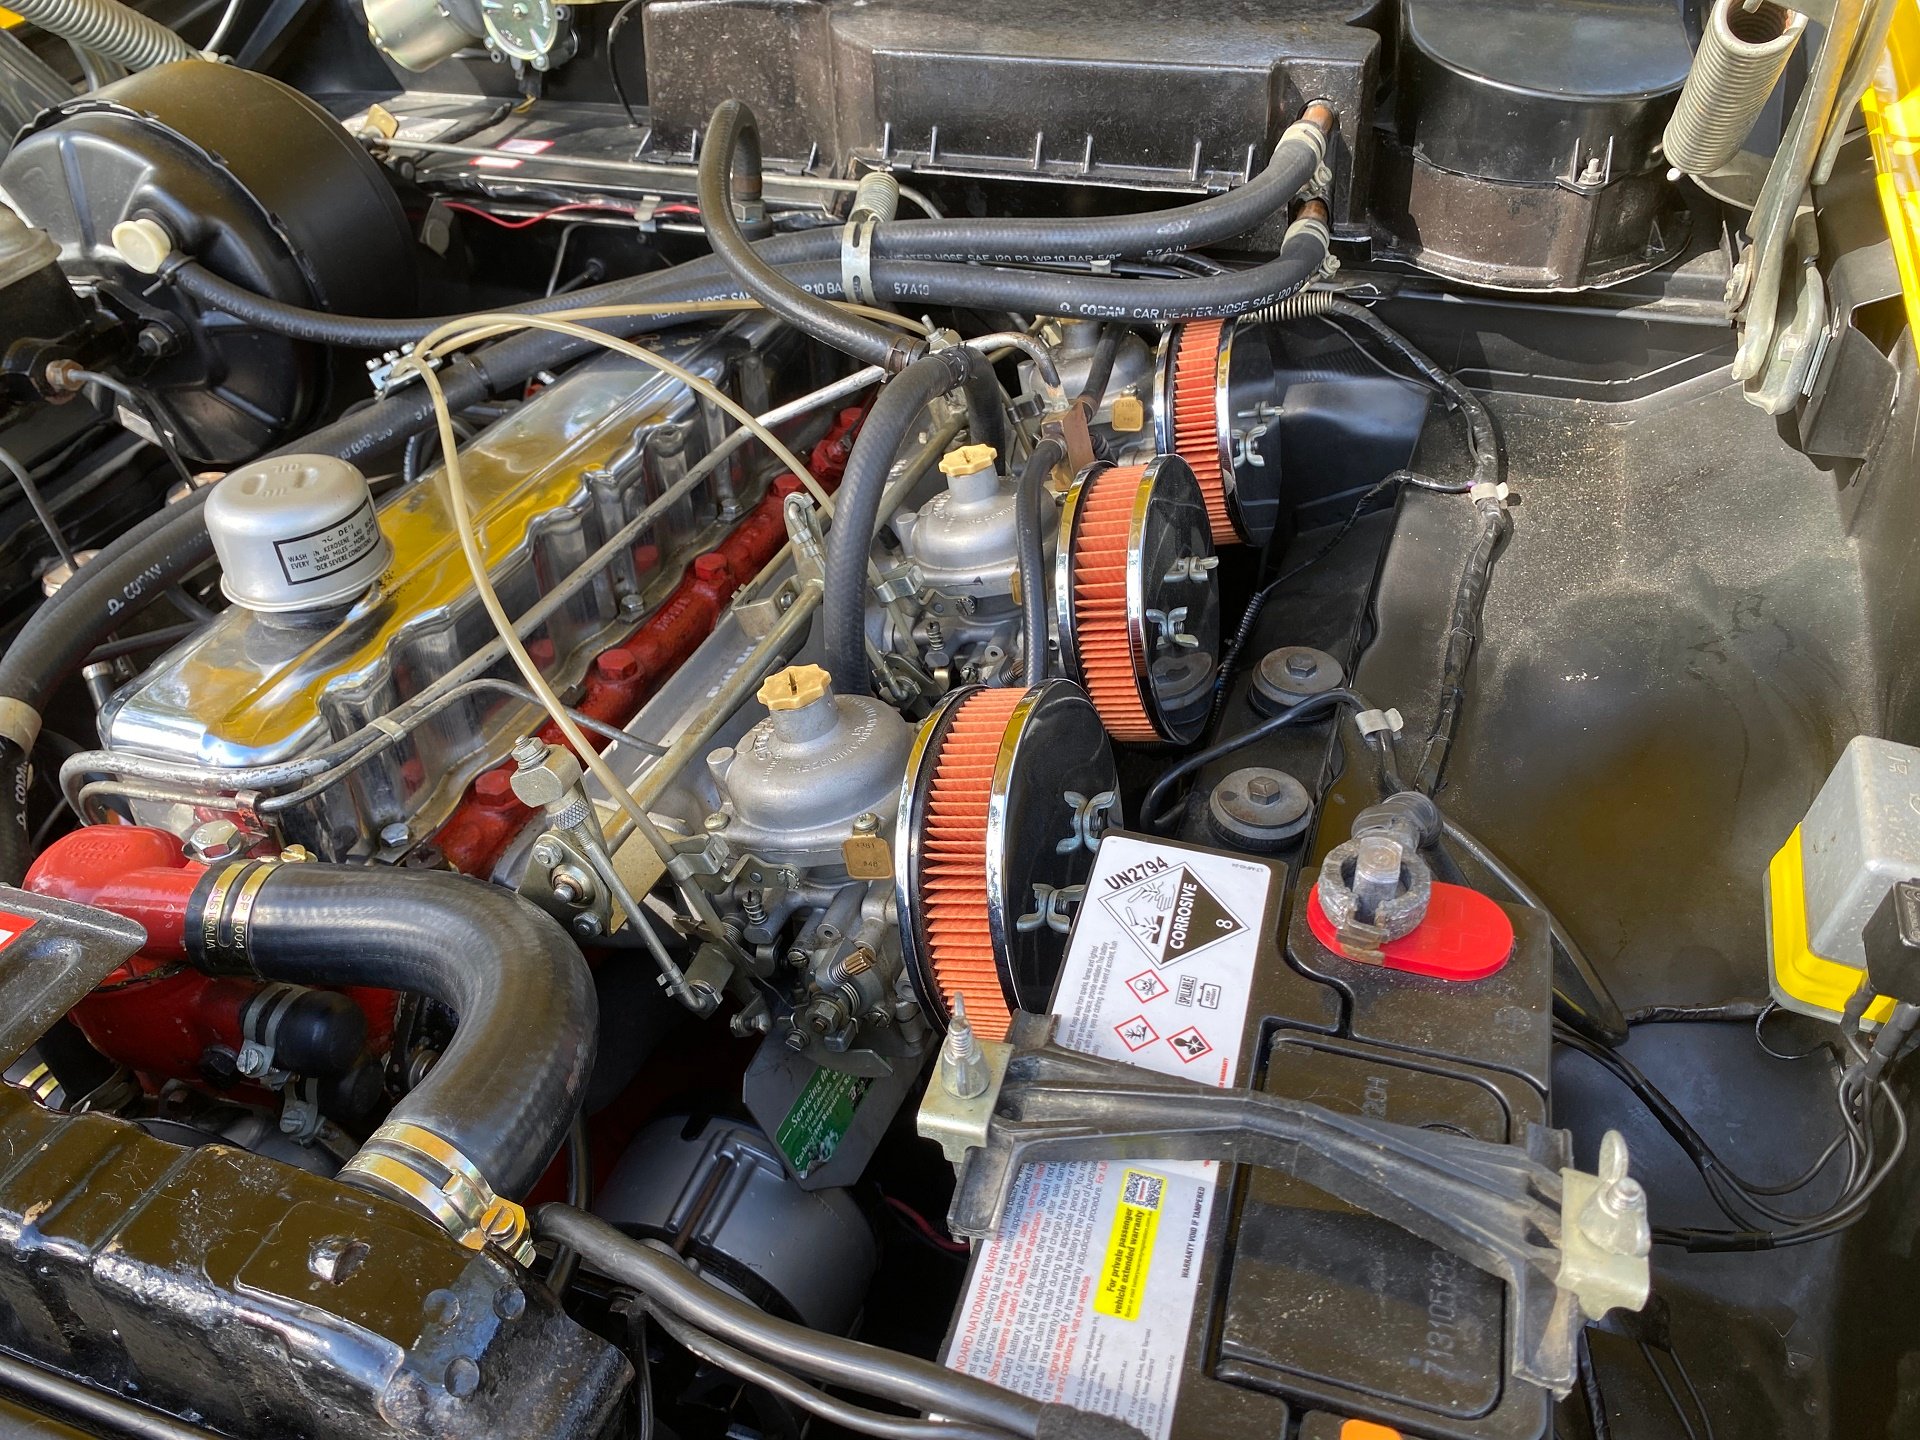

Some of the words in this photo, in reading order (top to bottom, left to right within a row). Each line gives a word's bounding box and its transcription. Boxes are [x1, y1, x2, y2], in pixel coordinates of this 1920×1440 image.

[827, 282, 842, 295] BA
[204, 289, 254, 319] VACUUM
[1132, 307, 1159, 319] CAR
[1163, 306, 1213, 319] HEATER
[1218, 300, 1249, 315] HOSE
[1252, 293, 1275, 307] SAE
[1275, 286, 1292, 301] J20
[288, 553, 308, 563] WASH
[323, 536, 350, 553] KEROSENE
[290, 560, 310, 570] EVERY
[332, 546, 348, 557] MILES
[329, 553, 348, 567] SEVERE
[1104, 856, 1169, 890] UN2794
[205, 887, 224, 950] AUSTRALIA
[1169, 882, 1198, 950] CORROSIVE
[1215, 918, 1233, 930] 8
[1177, 977, 1195, 1005] SPILLABLE
[791, 1080, 821, 1128] Servicing
[822, 1094, 840, 1121] Repairs
[1098, 1159, 1108, 1171] full
[1021, 1172, 1032, 1194] period
[1061, 1177, 1072, 1198] dealer
[1074, 1172, 1084, 1184] You
[1095, 1173, 1104, 1184] For
[1051, 1183, 1060, 1197] sale
[1082, 1189, 1090, 1197] of
[1046, 1199, 1055, 1215] after
[1057, 1199, 1067, 1210] the
[1078, 1198, 1089, 1217] place
[1192, 1186, 1204, 1217] TAMPERED
[1011, 1196, 1025, 1229] applicable
[1055, 1210, 1065, 1220] by
[1074, 1217, 1083, 1228] the
[1041, 1217, 1051, 1232] than
[1049, 1221, 1061, 1244] charge
[1059, 1213, 1073, 1248] applicable
[1188, 1227, 1197, 1241] VOID
[1004, 1230, 1015, 1251] stated
[1036, 1235, 1046, 1252] other
[1046, 1245, 1054, 1253] of
[1066, 1237, 1080, 1260] battery
[1077, 1223, 1092, 1264] adjudication
[1106, 1279, 1116, 1291] For
[1112, 1249, 1122, 1276] private
[1119, 1208, 1132, 1247] passenger
[996, 1328, 1009, 1358] systems
[1004, 1318, 1012, 1326] or
[1008, 1298, 1018, 1316] used
[1014, 1269, 1026, 1288] Deep
[1020, 1247, 1032, 1267] Cycle
[1037, 1183, 1050, 1206] Should
[1046, 1166, 1055, 1177] not
[999, 1253, 1009, 1264] the
[1041, 1254, 1052, 1267] free
[1054, 1250, 1064, 1261] the
[1115, 1285, 1126, 1313] vehicle
[1122, 1246, 1134, 1282] extended
[1130, 1210, 1144, 1244] warranty
[1182, 1243, 1193, 1277] WARRANTY
[995, 1266, 1005, 1275] for
[1029, 1255, 1040, 1279] reason
[1048, 1263, 1062, 1286] during
[1062, 1262, 1072, 1273] the
[979, 1365, 987, 1374] of
[994, 1290, 1011, 1321] Warranty
[1008, 1262, 1017, 1277] void
[1013, 1241, 1022, 1259] when
[1020, 1221, 1029, 1237] used
[1028, 1182, 1039, 1208] vehicles
[991, 1277, 1002, 1292] fault
[1024, 1281, 1035, 1296] any
[1034, 1269, 1048, 1300] replaced
[1069, 1266, 1083, 1296] warranty
[1043, 1289, 1054, 1310] made
[1055, 1274, 1071, 1306] returning
[967, 1275, 990, 1333] NATIONWIDE
[1019, 1298, 1029, 1308] for
[1030, 1302, 1039, 1312] be
[1050, 1307, 1062, 1317] by
[1064, 1298, 1074, 1310] the
[977, 1294, 998, 1346] manufacturing
[1015, 1311, 1026, 1325] test
[1028, 1312, 1036, 1325] will
[1060, 1312, 1070, 1322] for
[1007, 1328, 1022, 1354] battery
[1034, 1321, 1045, 1341] claim
[1044, 1318, 1059, 1349] warranty
[1055, 1324, 1067, 1350] receipt
[972, 1347, 982, 1362] any
[1018, 1334, 1032, 1362] misuse,
[1029, 1343, 1039, 1361] valid
[1039, 1351, 1049, 1363] the
[1056, 1376, 1065, 1392] and
[1061, 1336, 1076, 1375] conditions,
[1071, 1320, 1079, 1332] visit
[1075, 1305, 1083, 1317] our
[1015, 1363, 1022, 1371] or
[1035, 1365, 1045, 1387] under
[1048, 1352, 1060, 1380] original
[1078, 1351, 1091, 1385] SuperCharge
[1043, 1382, 1053, 1395] the
[1095, 1372, 1105, 1395] Australia
